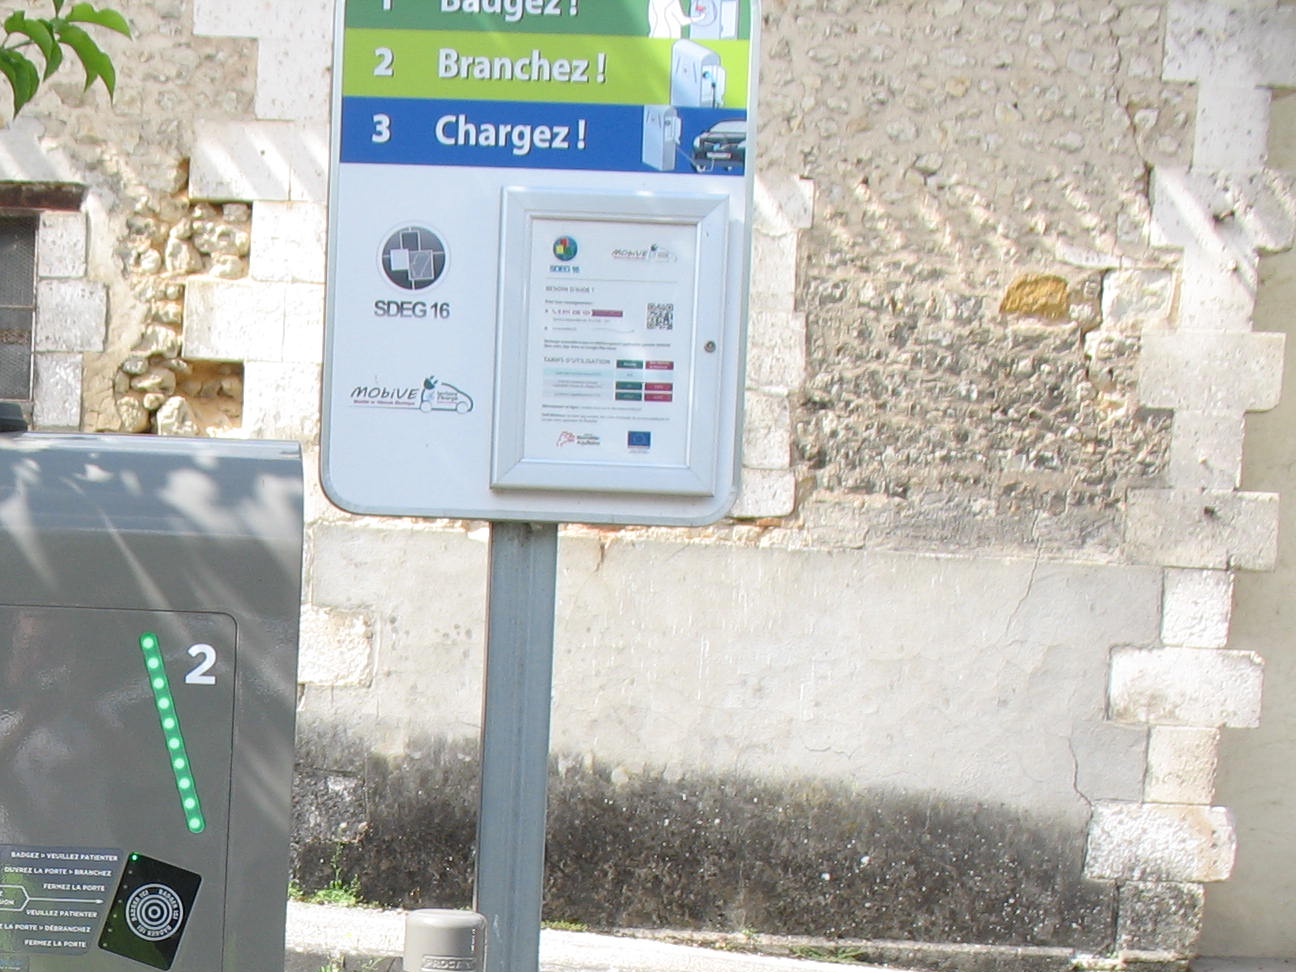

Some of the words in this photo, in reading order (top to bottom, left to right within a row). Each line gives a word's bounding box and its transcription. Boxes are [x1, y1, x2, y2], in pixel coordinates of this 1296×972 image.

[373, 47, 395, 77] 2
[371, 114, 391, 143] 3
[374, 300, 427, 318] SDEG
[430, 302, 450, 319] 16
[185, 643, 217, 685] 2
[10, 851, 40, 859] BADGEZ
[46, 852, 79, 860] VEUILLEZ
[4, 866, 33, 874] OUVREZ
[43, 883, 71, 891] FERMEZ
[26, 909, 58, 917] VEUILLEZ
[15, 923, 37, 931] PORTE
[24, 939, 52, 947] FERMEZ
[64, 940, 87, 948] PORTE
